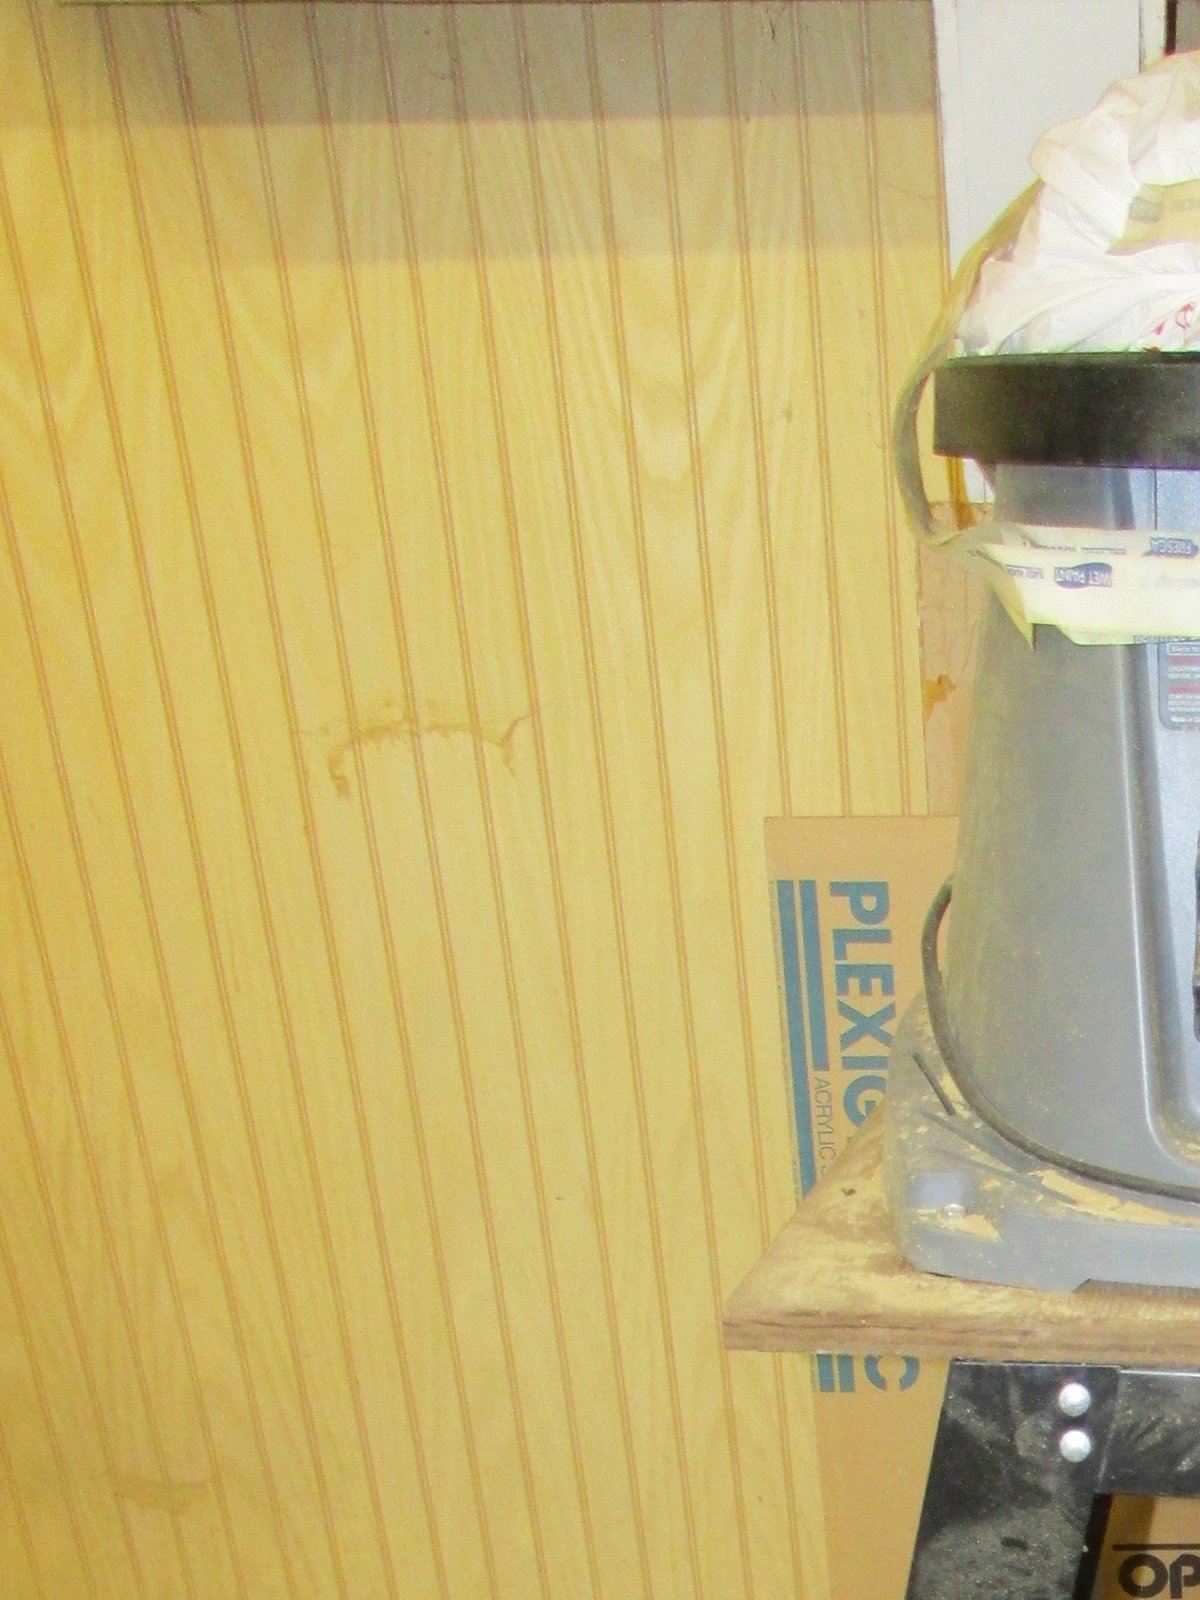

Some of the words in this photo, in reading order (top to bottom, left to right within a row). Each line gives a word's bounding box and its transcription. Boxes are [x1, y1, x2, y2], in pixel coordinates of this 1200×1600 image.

[1054, 567, 1086, 584] PAINT
[1087, 568, 1111, 584] WET
[814, 1075, 837, 1161] ACRYLIC
